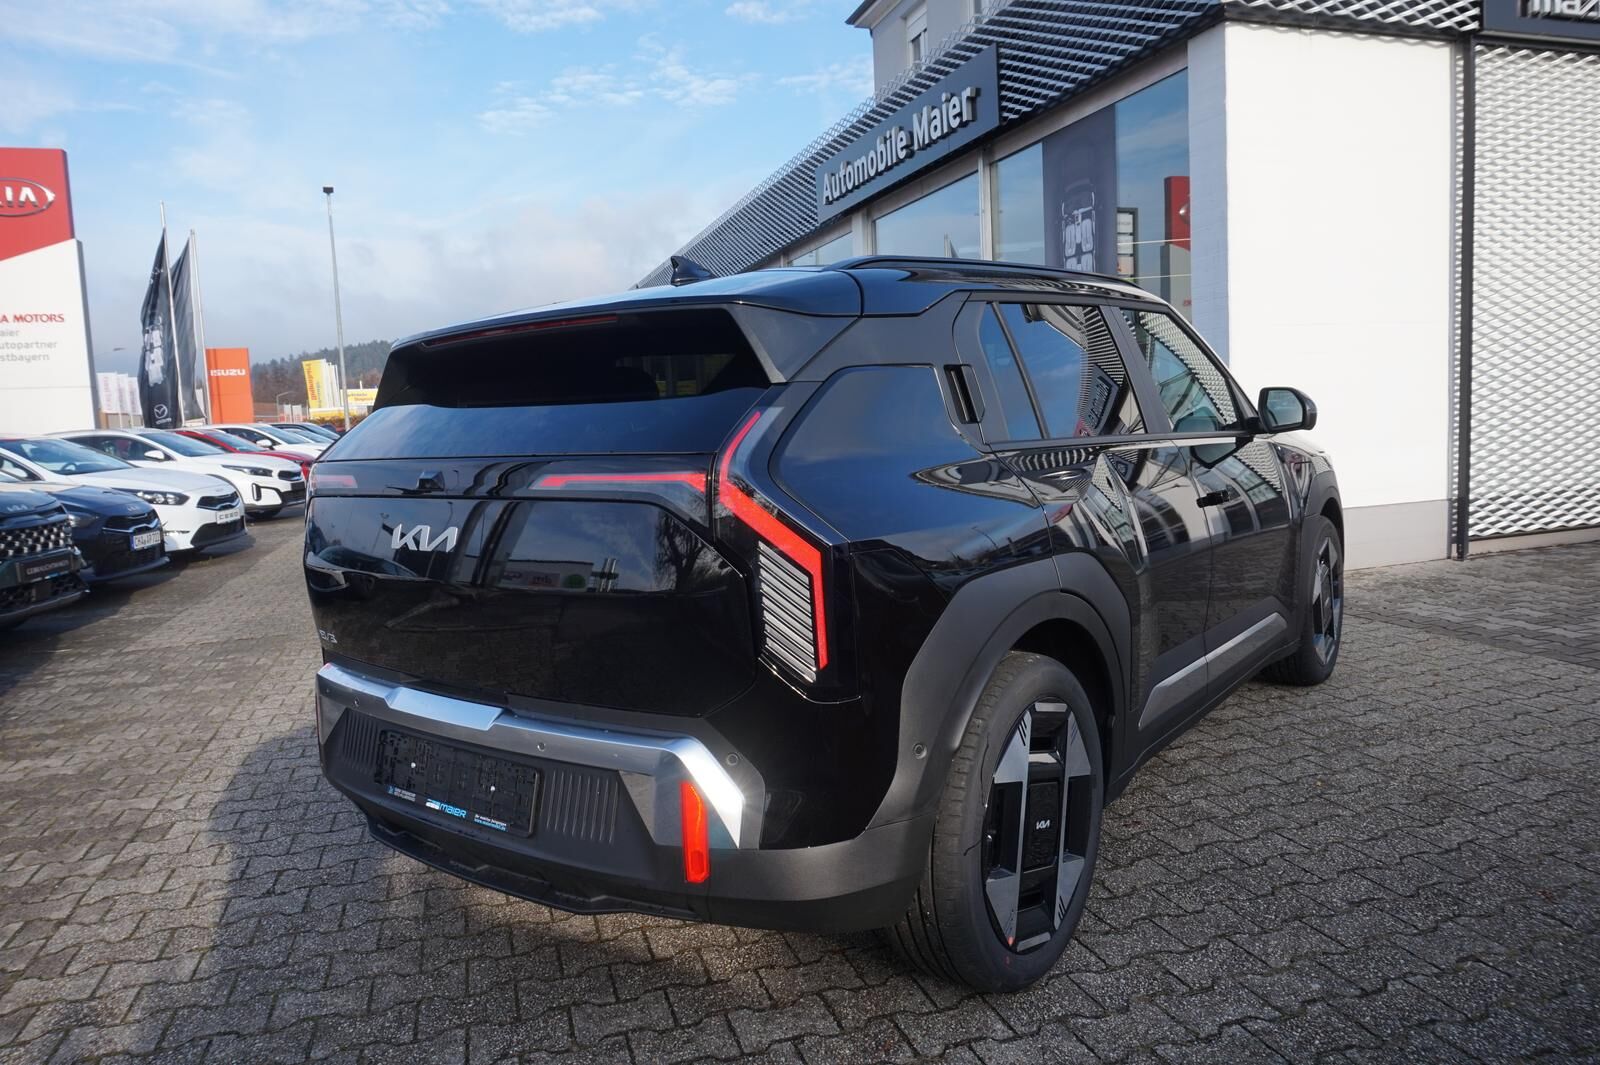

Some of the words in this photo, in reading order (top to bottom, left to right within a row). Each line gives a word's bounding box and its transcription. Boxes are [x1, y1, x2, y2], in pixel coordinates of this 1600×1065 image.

[823, 127, 908, 205] Automobile
[912, 86, 974, 150] Maier
[13, 313, 65, 323] MOTORS
[210, 369, 246, 377] ISUZU
[391, 523, 458, 553] KIA
